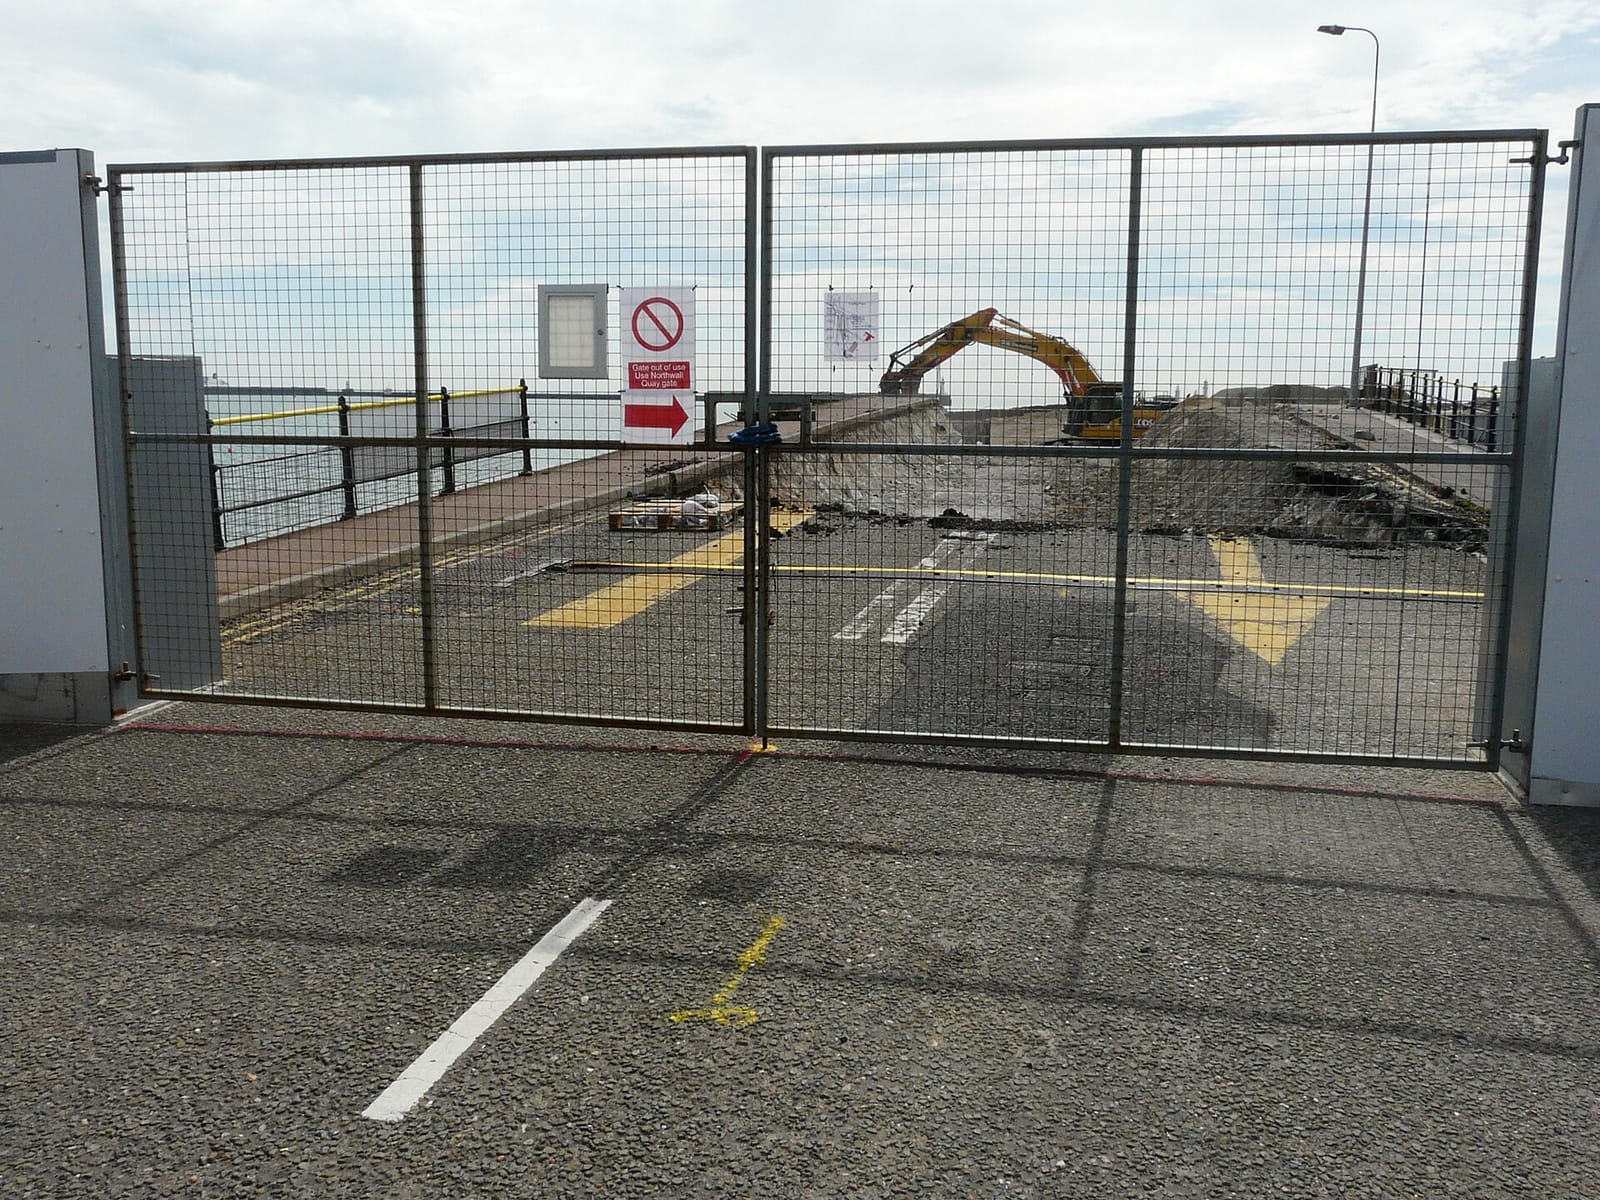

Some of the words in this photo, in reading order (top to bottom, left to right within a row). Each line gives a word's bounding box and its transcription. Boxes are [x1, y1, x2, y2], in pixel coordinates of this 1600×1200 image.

[663, 363, 671, 371] of
[641, 380, 660, 388] Quay
[661, 380, 677, 388] gate
